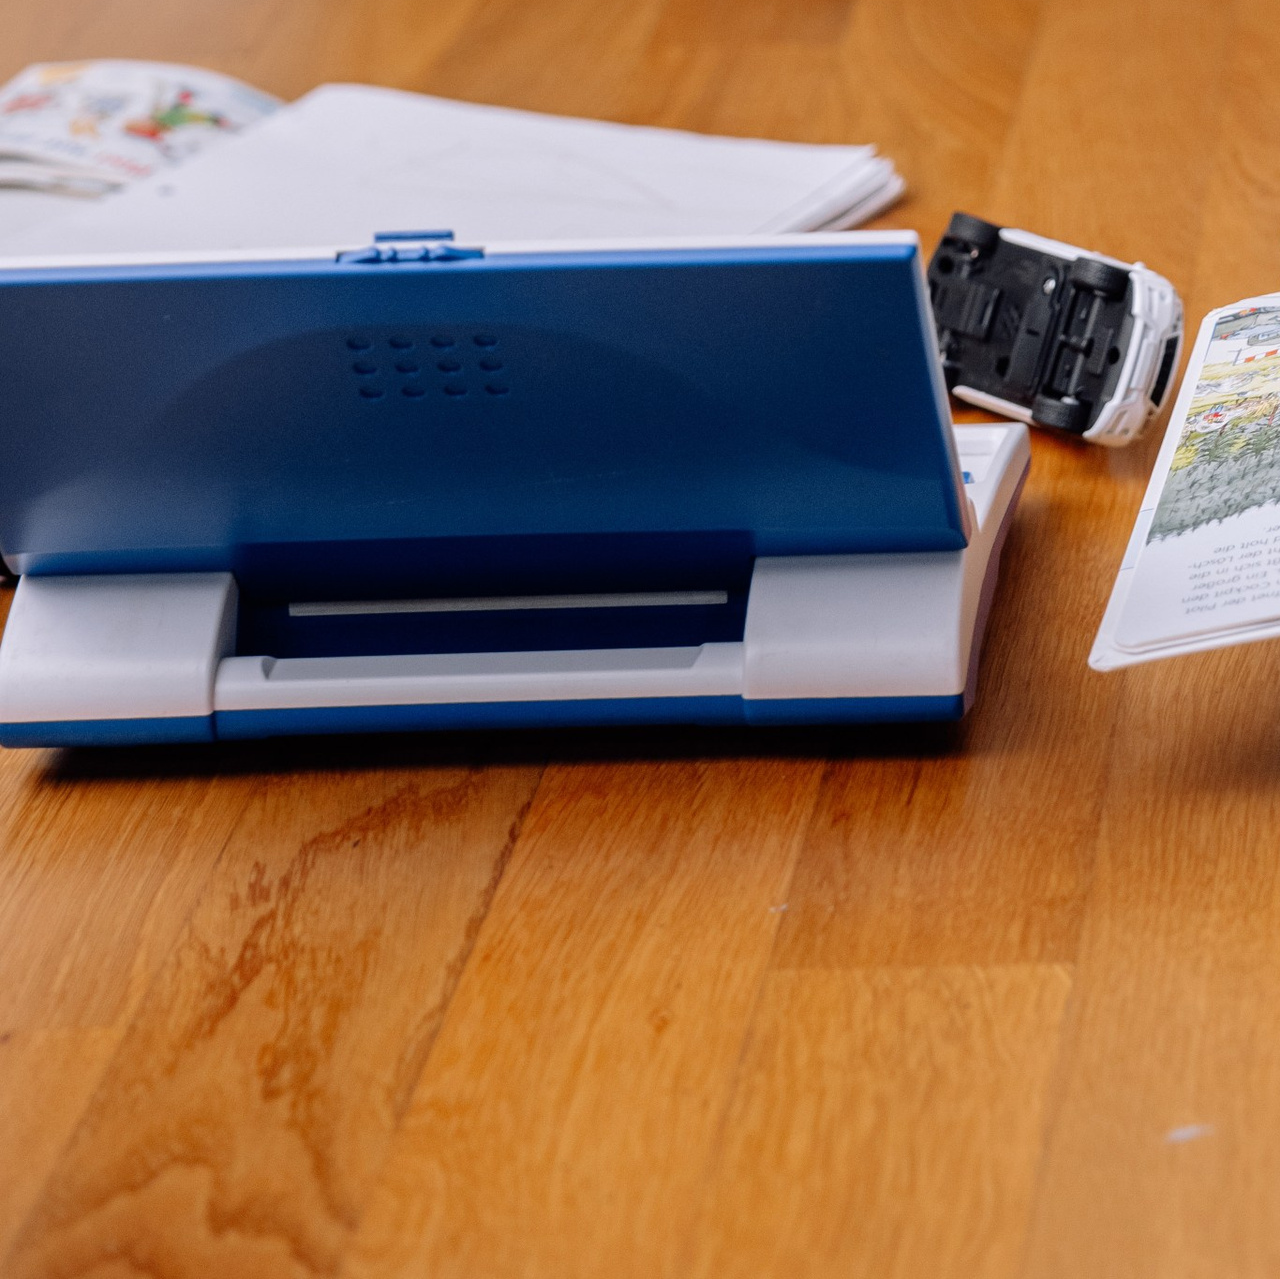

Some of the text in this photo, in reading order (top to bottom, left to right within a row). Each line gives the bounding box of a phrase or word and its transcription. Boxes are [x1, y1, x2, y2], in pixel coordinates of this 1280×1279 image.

[1213, 544, 1234, 552] die
[1240, 537, 1268, 549] holt
[1238, 549, 1262, 558] der
[1234, 560, 1261, 572] sich
[1188, 570, 1210, 579] die
[1245, 570, 1267, 579] Ein
[1192, 573, 1241, 590] großer
[1212, 580, 1269, 598] Cockpit
[1181, 592, 1208, 602] den
[1221, 596, 1246, 606] der
[1184, 602, 1215, 615] Pilot
